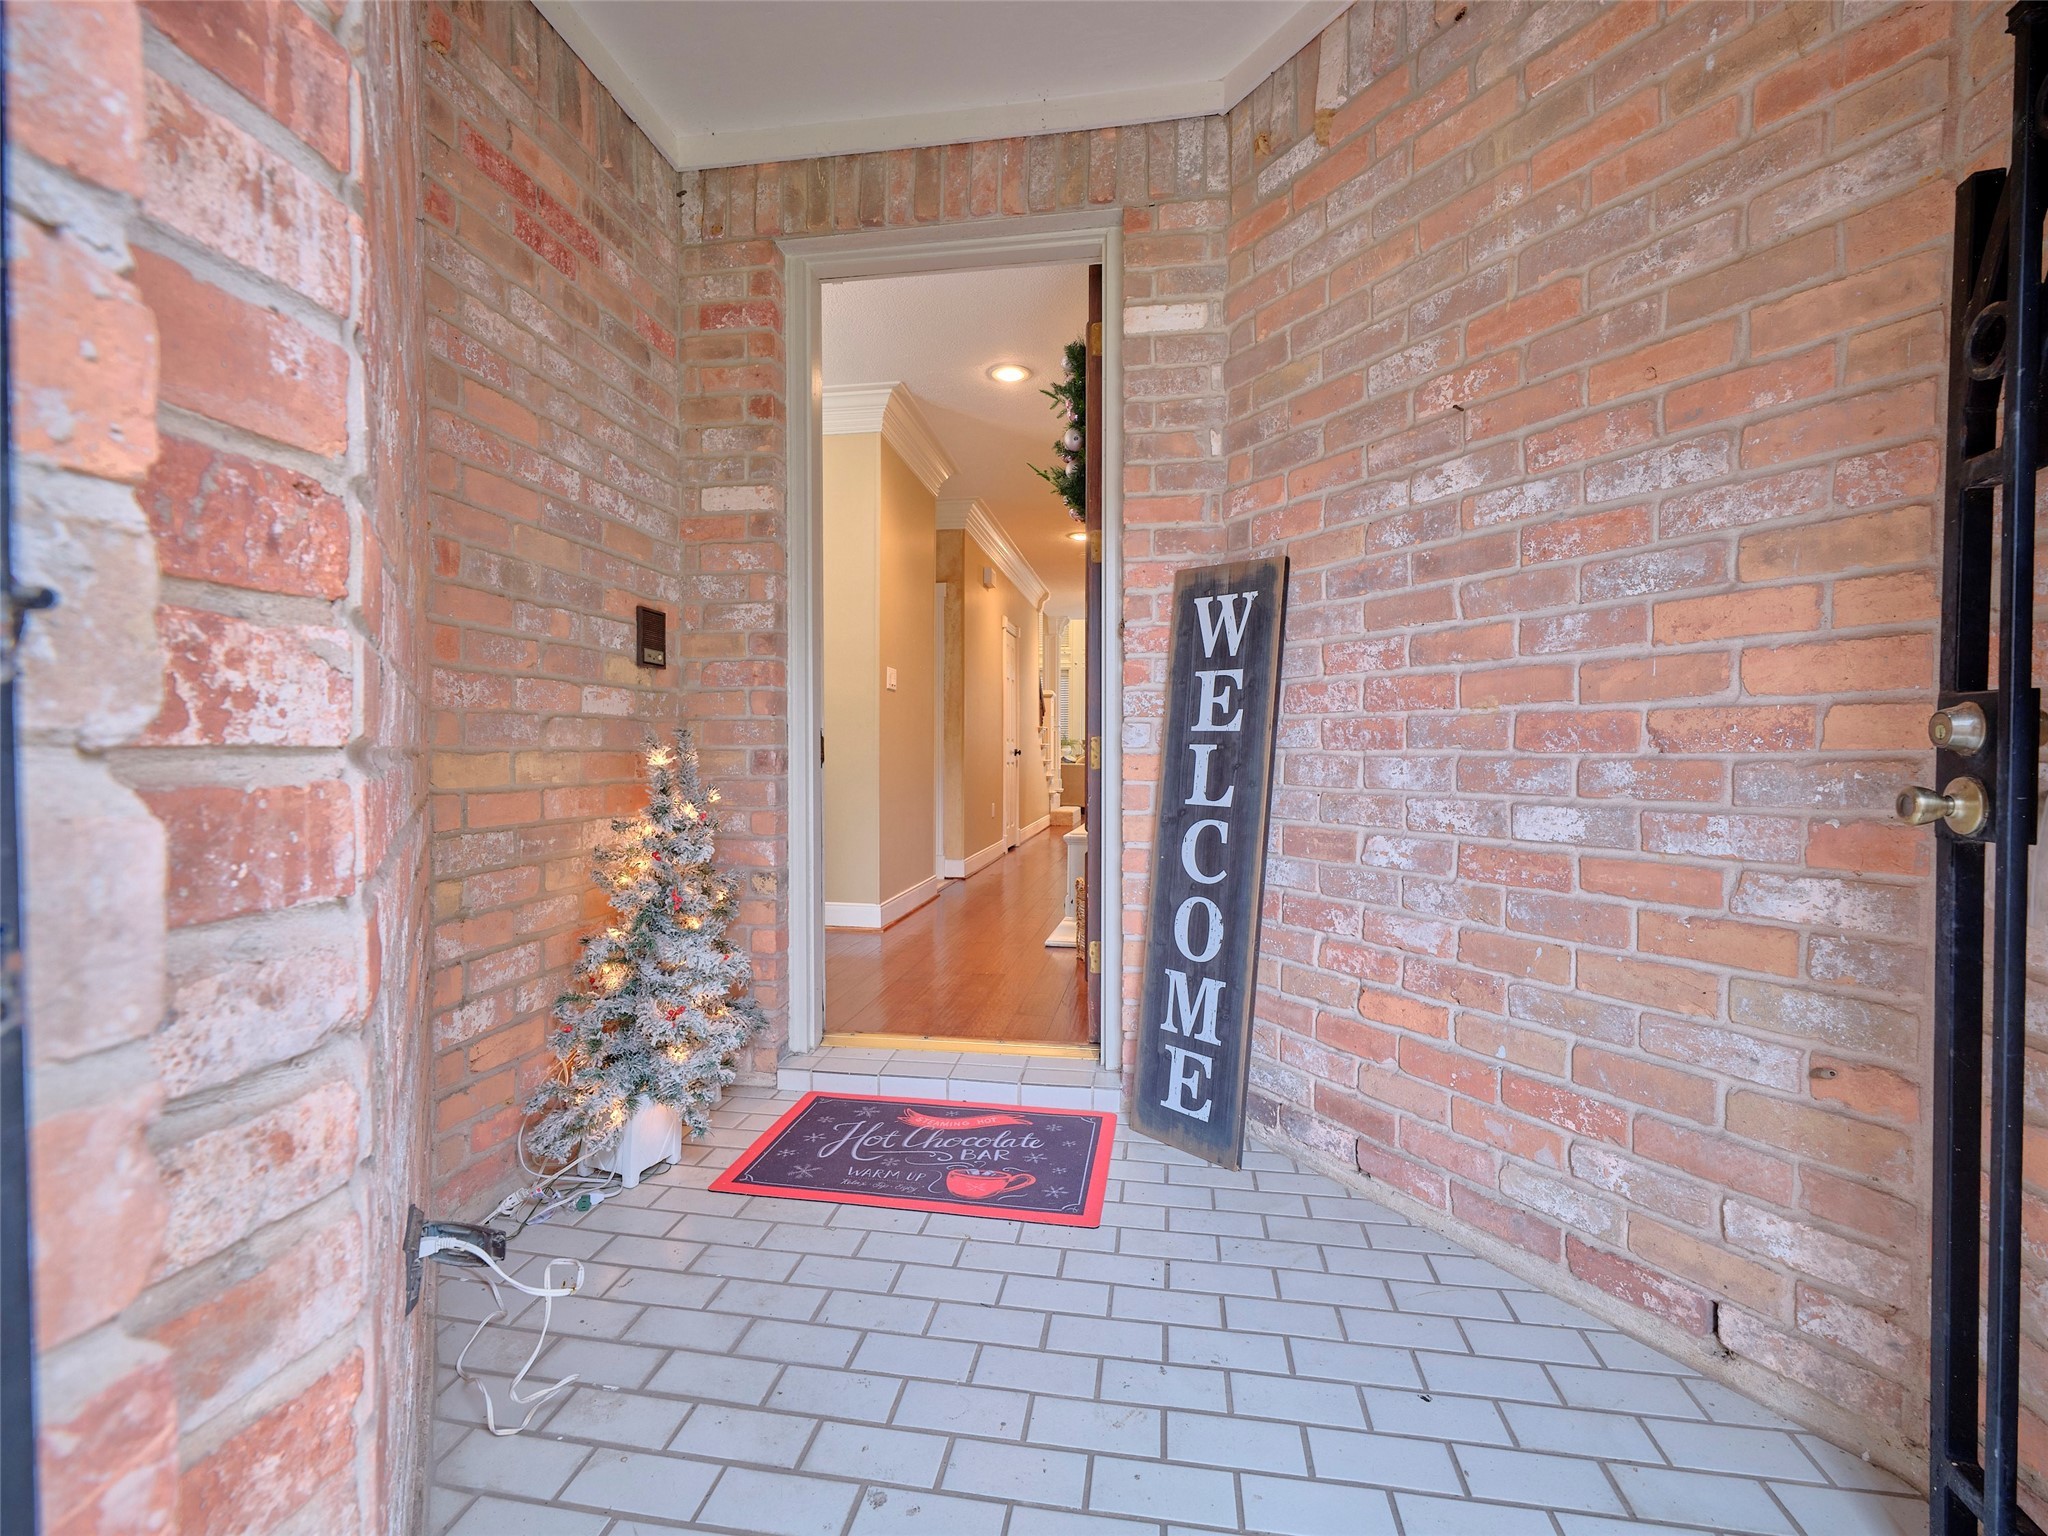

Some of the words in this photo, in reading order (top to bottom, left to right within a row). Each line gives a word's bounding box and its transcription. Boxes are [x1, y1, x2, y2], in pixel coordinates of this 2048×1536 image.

[1159, 590, 1259, 1123] WELCOME
[915, 1116, 970, 1127] STEAMING
[817, 1120, 901, 1161] Hot
[901, 1125, 1045, 1149] Chocolate
[960, 1149, 1011, 1161] BAR
[848, 1166, 900, 1179] WARM
[906, 1172, 926, 1181] UP
